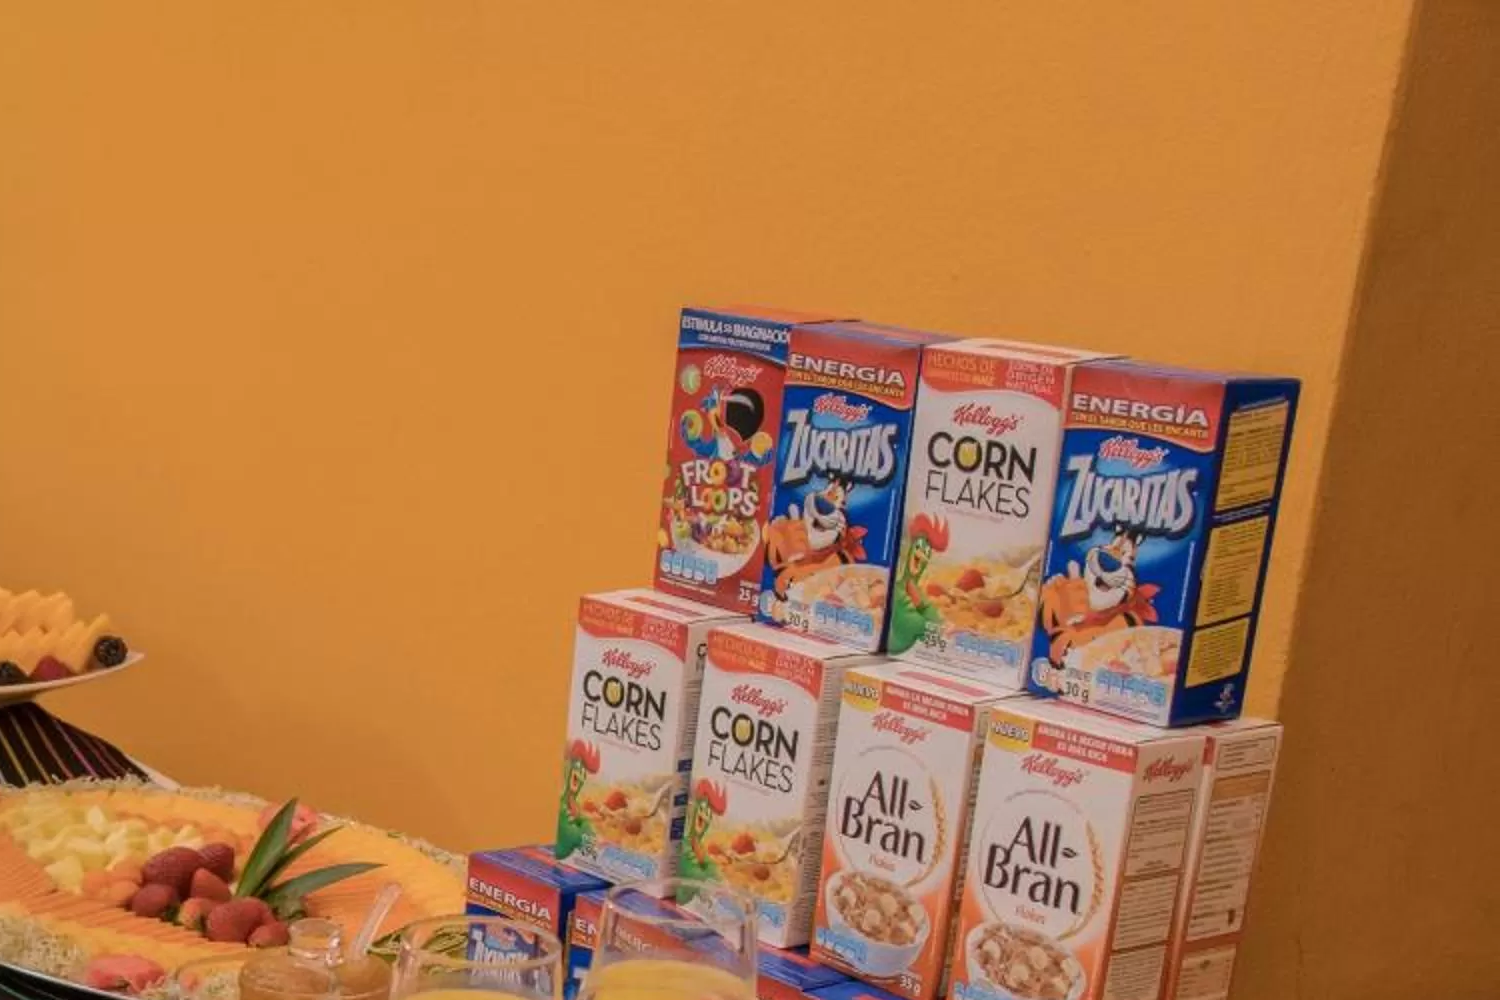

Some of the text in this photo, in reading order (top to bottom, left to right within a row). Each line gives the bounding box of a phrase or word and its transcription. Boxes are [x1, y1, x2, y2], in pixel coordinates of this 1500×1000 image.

[953, 401, 1019, 436] Kellogg's
[782, 408, 897, 485] ZUCARITAS
[927, 431, 1037, 486] CORN
[1099, 435, 1166, 471] Kellogg's
[681, 459, 757, 487] FROOT
[925, 469, 1031, 519] FLAKES
[1061, 454, 1197, 537] ZUCARITAS
[690, 485, 759, 517] LOOPS
[602, 648, 653, 679] Kellogg's
[583, 670, 667, 721] CORN
[730, 684, 784, 717] Kellogg's
[581, 702, 661, 751] FLAKES
[711, 705, 799, 763] CORN
[872, 712, 927, 744] Kellogg's
[707, 739, 794, 794] FLAKES
[1021, 753, 1084, 788] Kellogg's
[841, 796, 926, 865] Bran
[983, 844, 1080, 915] Bran
